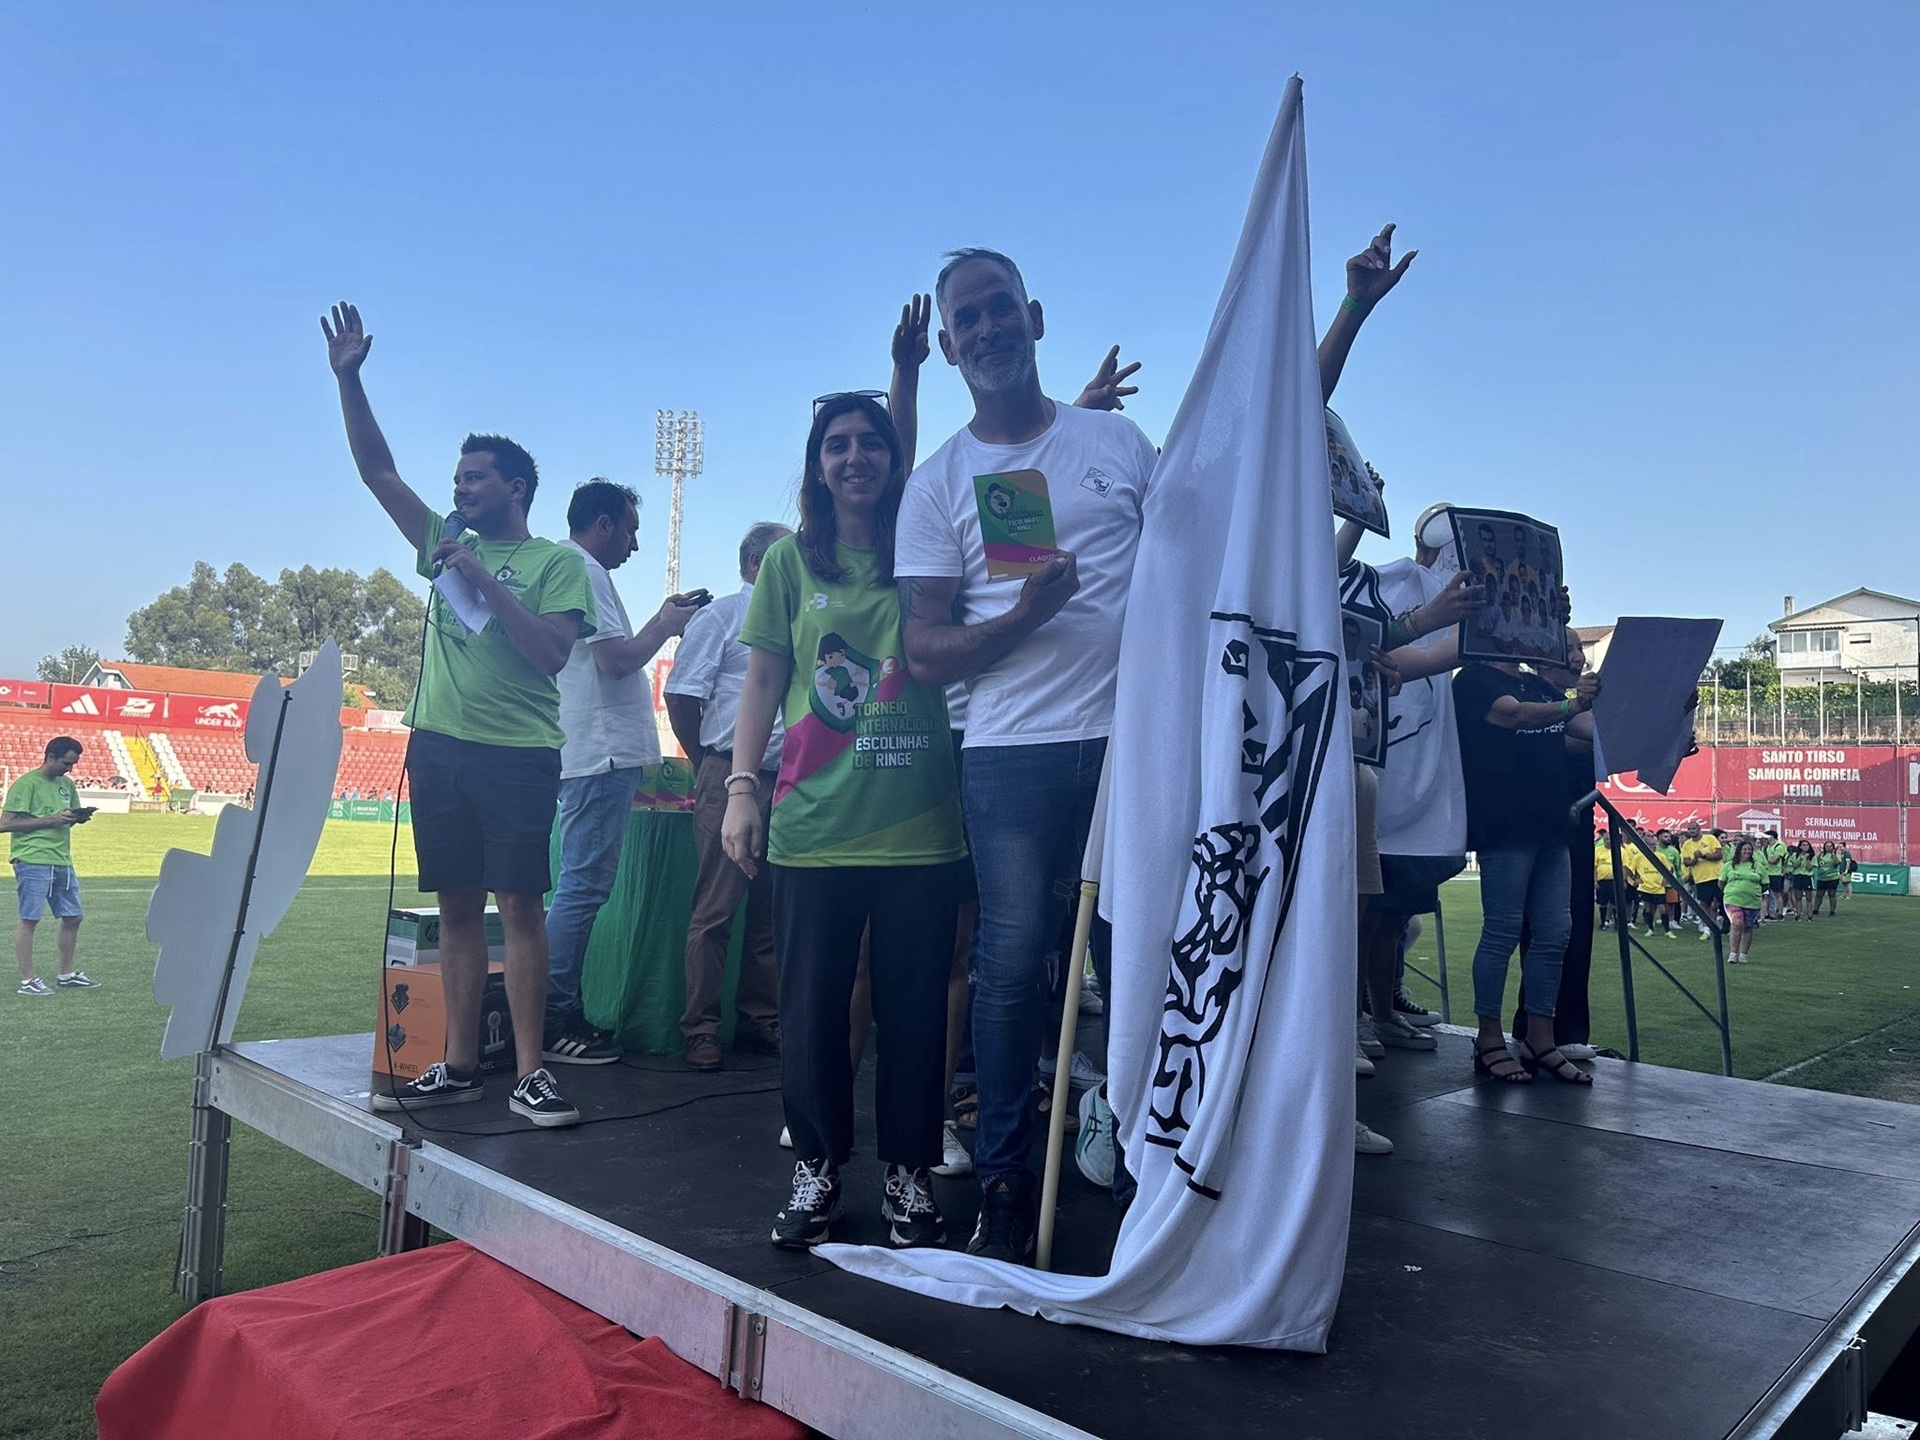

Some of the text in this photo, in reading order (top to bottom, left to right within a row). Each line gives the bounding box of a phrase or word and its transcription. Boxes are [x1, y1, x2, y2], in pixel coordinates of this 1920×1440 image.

[1029, 553, 1055, 563] CLAQU
[856, 701, 907, 716] TORNEIO
[195, 717, 221, 726] UNDER
[855, 736, 929, 751] ESCOLINHAS
[855, 752, 912, 768] DE RINGE
[1762, 750, 1845, 763] SANTO TIRSO
[1748, 768, 1860, 781] SAMORA CORREIA
[1783, 784, 1823, 797] LEIRIA
[1805, 817, 1856, 828] SERRALHARIA
[1784, 829, 1807, 839] FILIPE
[1808, 830, 1842, 840] MARTINS
[1842, 832, 1878, 841] UNIP.LDA
